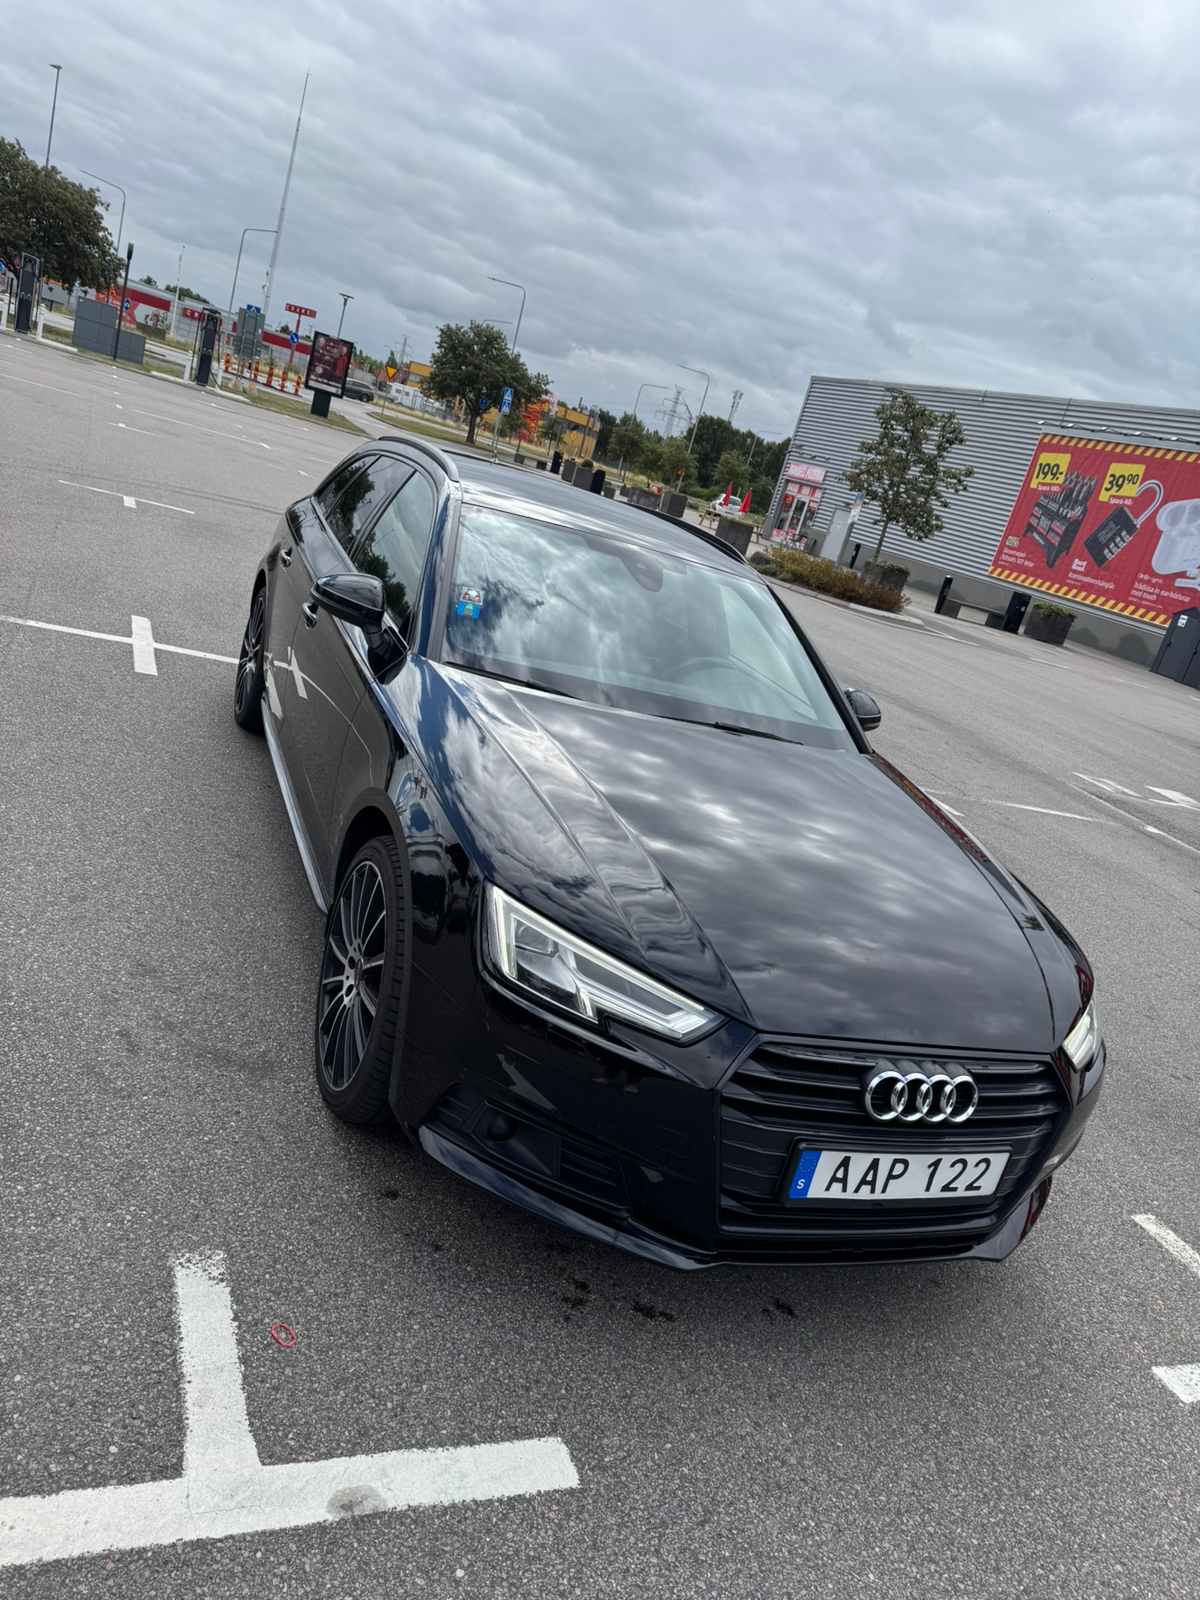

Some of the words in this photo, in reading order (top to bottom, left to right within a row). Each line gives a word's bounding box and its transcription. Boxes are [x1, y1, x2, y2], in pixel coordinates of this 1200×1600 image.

[286, 304, 311, 316] CRAMO
[1037, 484, 1050, 492] Spara
[1108, 496, 1123, 505] Spara
[1133, 581, 1154, 593] Trådlösa
[1130, 589, 1142, 597] med
[1142, 592, 1157, 601] touch
[824, 1155, 910, 1194] AAP
[924, 1157, 992, 1193] 122
[796, 1178, 805, 1190] S
